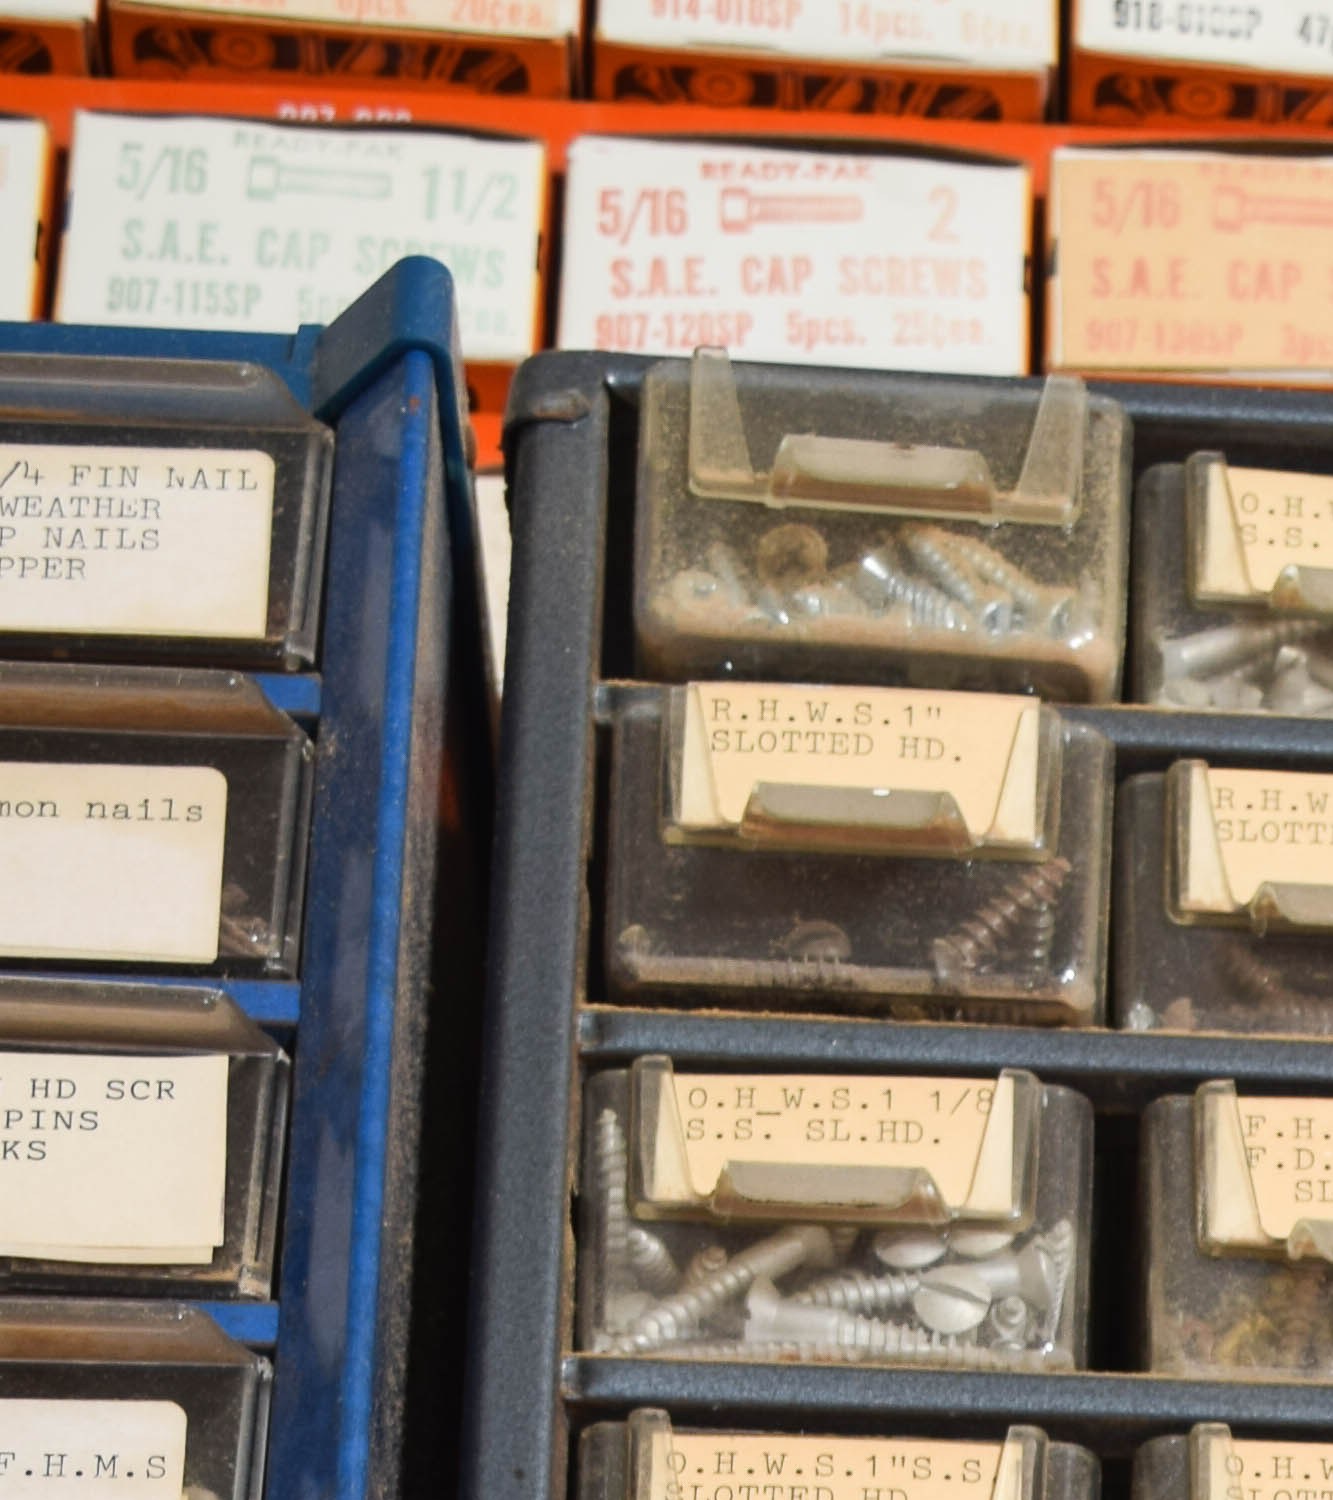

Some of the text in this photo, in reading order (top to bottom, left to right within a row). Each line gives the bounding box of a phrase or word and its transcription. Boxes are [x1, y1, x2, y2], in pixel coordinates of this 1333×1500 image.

[115, 140, 210, 202] 5/16
[597, 185, 961, 245] 5/16 2
[1090, 178, 1183, 237] 5/16
[121, 219, 331, 271] S.A.E. CAP
[610, 256, 990, 300] S.A.E. CAP SCREWS
[1226, 260, 1302, 301] CAP
[784, 312, 869, 350] 5pcs.
[69, 463, 140, 489] FIN
[0, 496, 163, 521] WEATHER
[43, 526, 162, 551] NAILS
[711, 730, 961, 762] SLOTTED HD.
[84, 797, 205, 824] nails
[29, 1077, 176, 1101] HD SCR
[686, 1118, 772, 1142] S.S.
